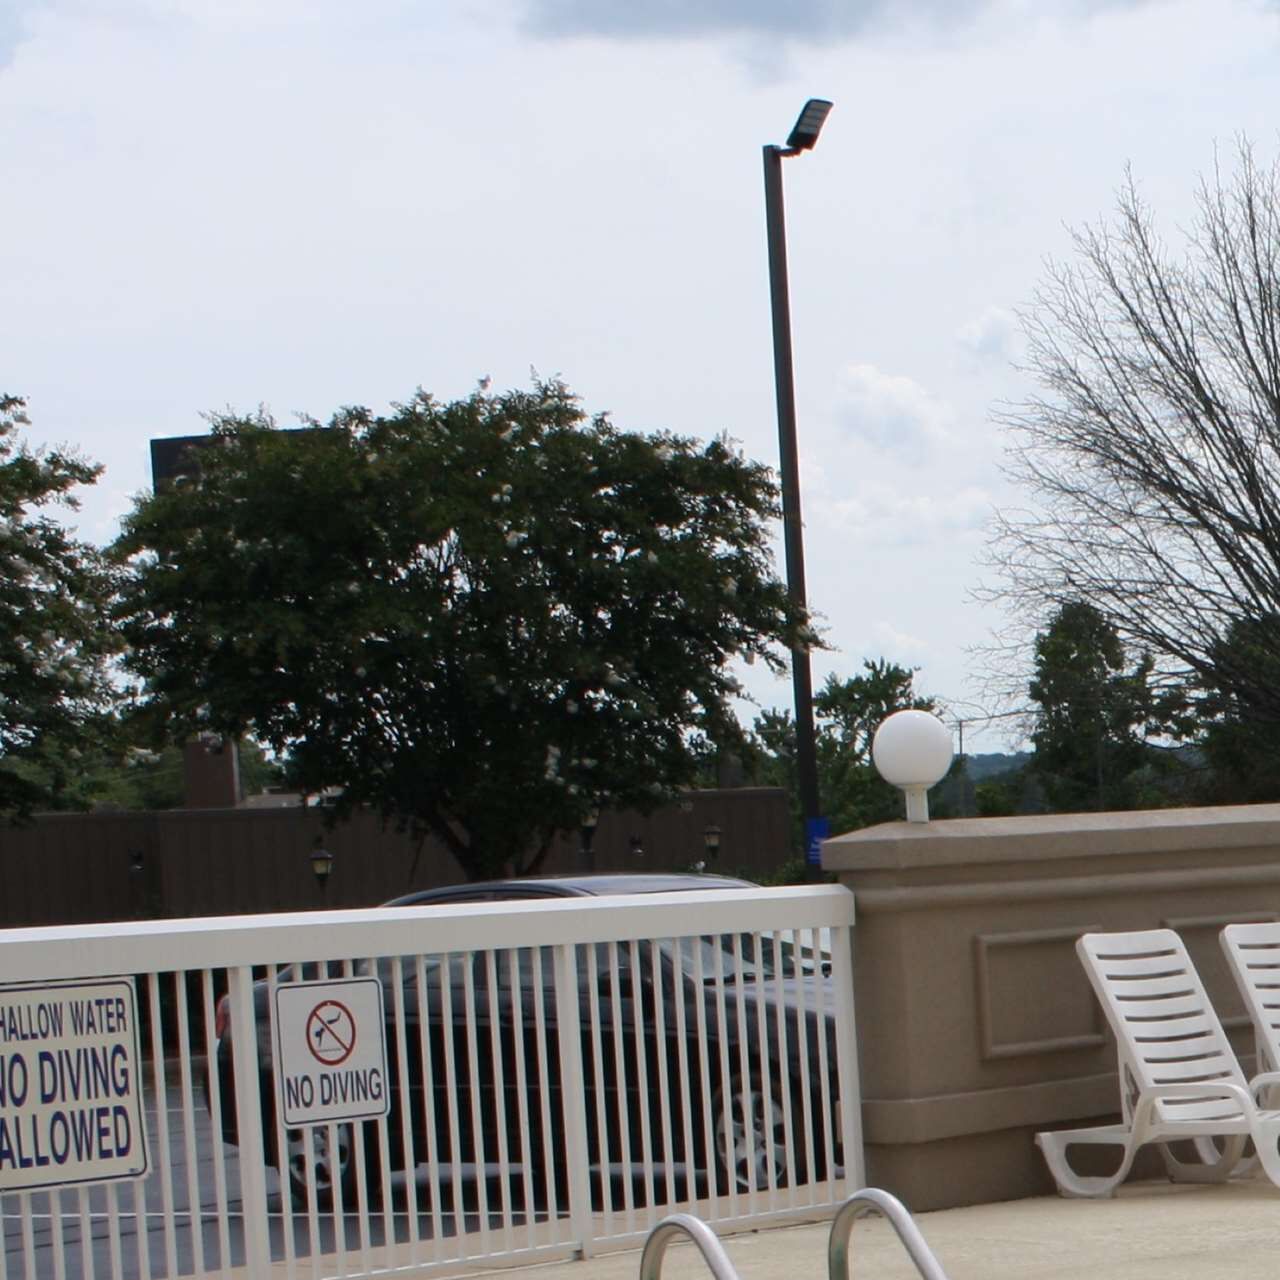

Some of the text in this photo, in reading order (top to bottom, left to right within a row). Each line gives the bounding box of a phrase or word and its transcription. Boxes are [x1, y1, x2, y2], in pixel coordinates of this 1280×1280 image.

[69, 997, 127, 1037] WATER
[38, 1044, 130, 1105] DIVING
[287, 1068, 383, 1111] NO DIVING
[0, 1105, 132, 1171] ALLOWED
